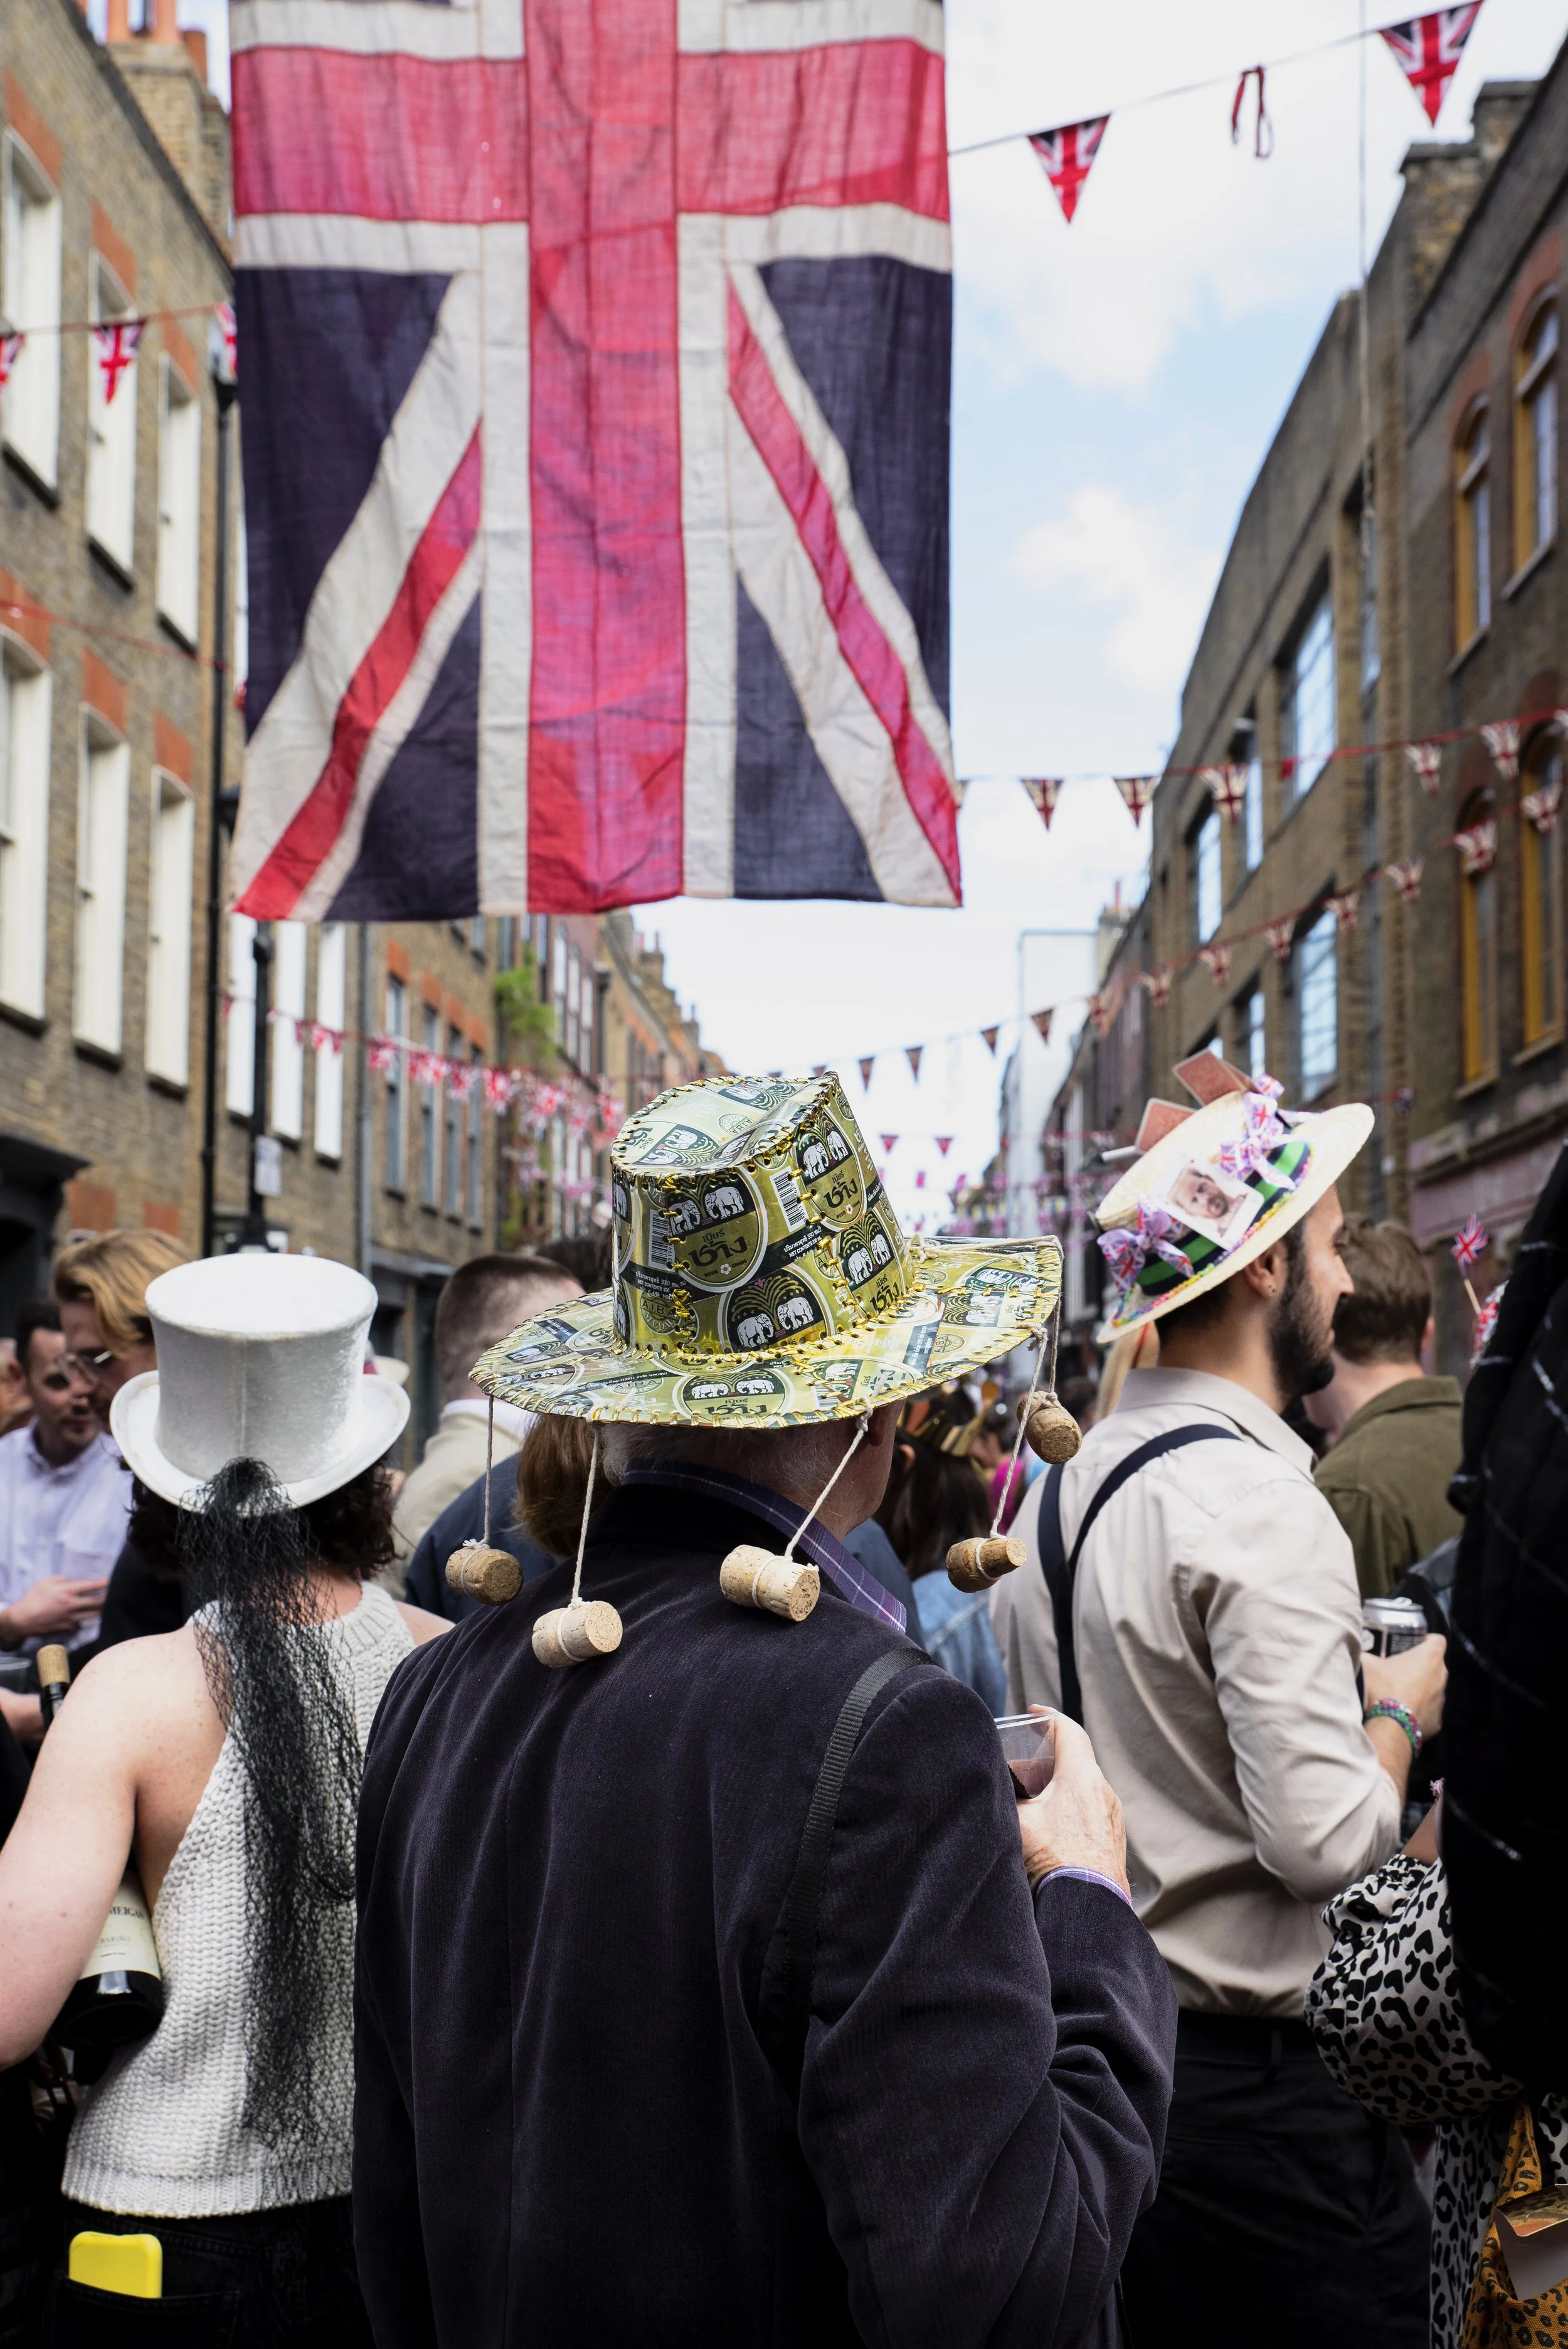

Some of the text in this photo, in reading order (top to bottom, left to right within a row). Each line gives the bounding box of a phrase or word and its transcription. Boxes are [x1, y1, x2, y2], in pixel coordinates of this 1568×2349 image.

[832, 1170, 844, 1184] เบียร์
[823, 1178, 859, 1209] ช้าง
[836, 1211, 847, 1219] BEER
[702, 1228, 725, 1242] เบียร์
[688, 1236, 748, 1267] ช้าง
[797, 1243, 813, 1254] CONTENTS
[731, 1259, 747, 1268] CHANG
[644, 1281, 662, 1291] CONTENTS
[876, 1273, 888, 1288] เบียร์
[869, 1281, 901, 1313] ช้าง
[861, 1376, 871, 1387] เบียร์
[704, 1403, 768, 1416] ช้าง
